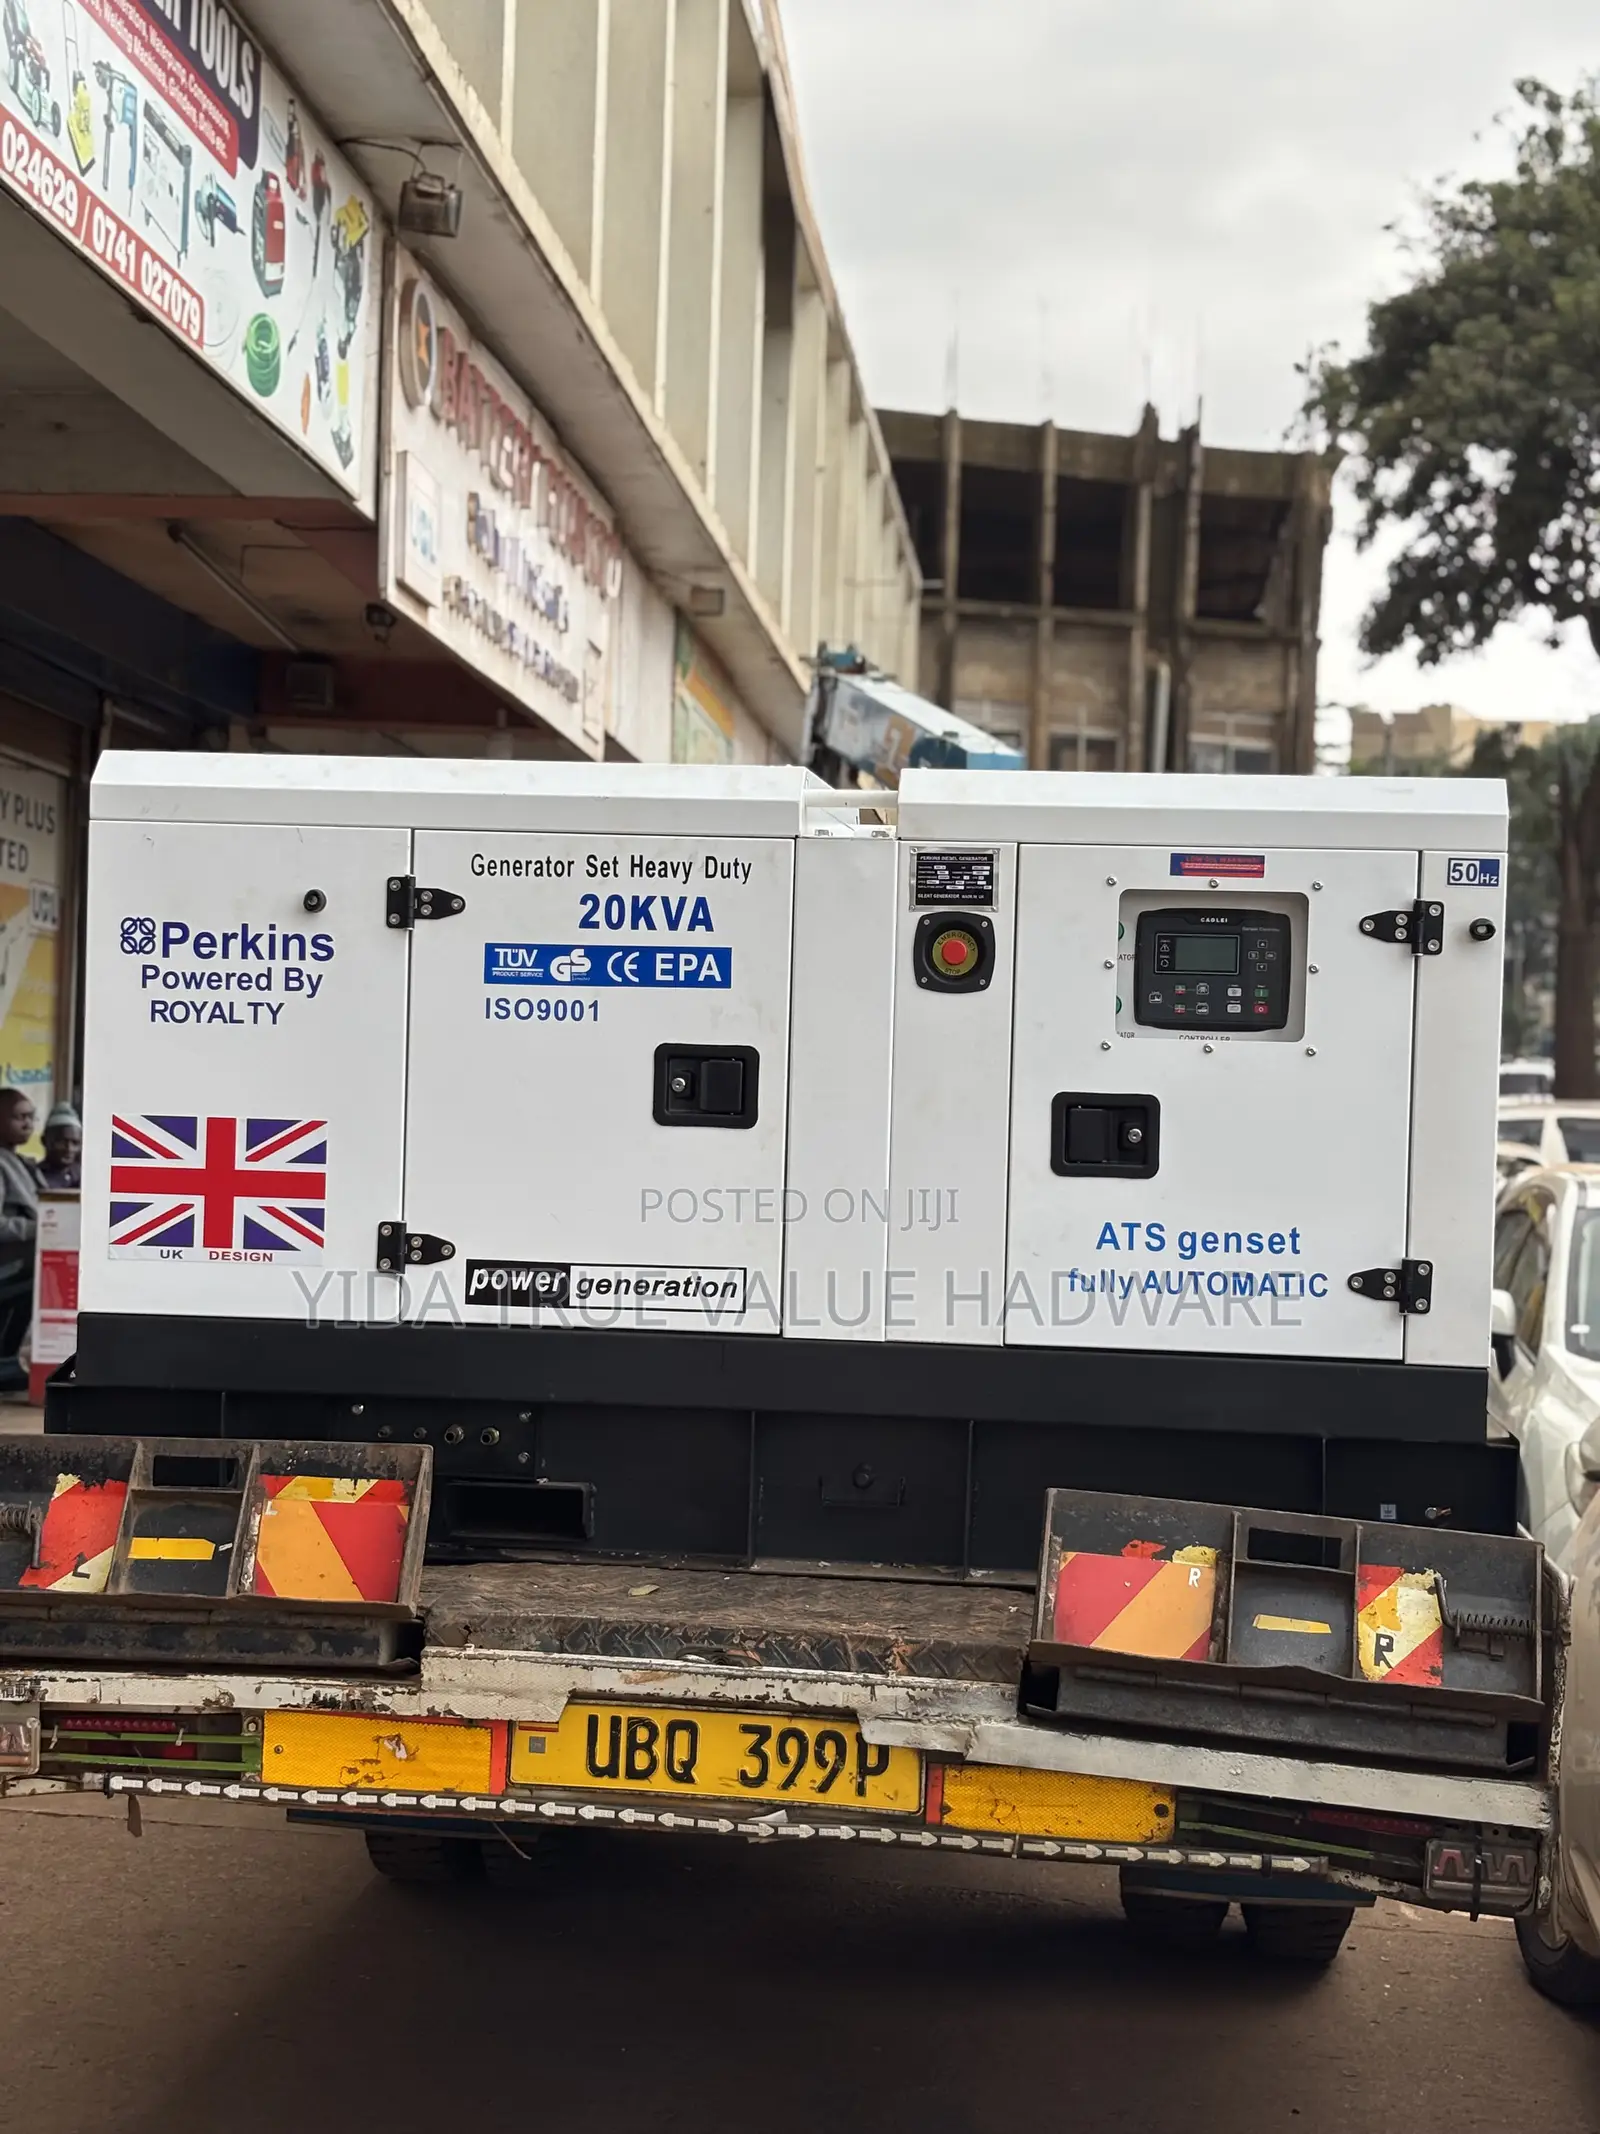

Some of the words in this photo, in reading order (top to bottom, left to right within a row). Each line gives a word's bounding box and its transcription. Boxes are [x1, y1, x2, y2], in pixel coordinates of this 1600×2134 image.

[92, 206, 136, 282] 0741
[141, 251, 200, 340] 027079
[15, 794, 54, 834] PLUS
[471, 853, 574, 879] Generator
[586, 854, 619, 880] Set
[630, 855, 693, 885] Heavy
[705, 856, 752, 884] Duty
[579, 894, 714, 932] 20KVA
[161, 922, 335, 962] Perkins
[141, 964, 273, 992] Powered
[283, 966, 324, 998] By
[495, 948, 538, 967] TÜV
[607, 951, 639, 982] CE
[655, 953, 722, 982] EPA
[151, 1000, 285, 1026] ROYALTY
[485, 997, 599, 1022] ISO9001
[160, 1250, 183, 1260] UK
[209, 1251, 273, 1262] DESIGN
[1096, 1222, 1165, 1252] ATS
[1178, 1227, 1301, 1260] genset
[469, 1265, 567, 1297] power
[576, 1274, 739, 1299] generation
[1068, 1268, 1134, 1300] fully
[1141, 1270, 1328, 1298] AUTOMATIC
[1374, 1633, 1394, 1669] R
[587, 1714, 699, 1784] UBQ
